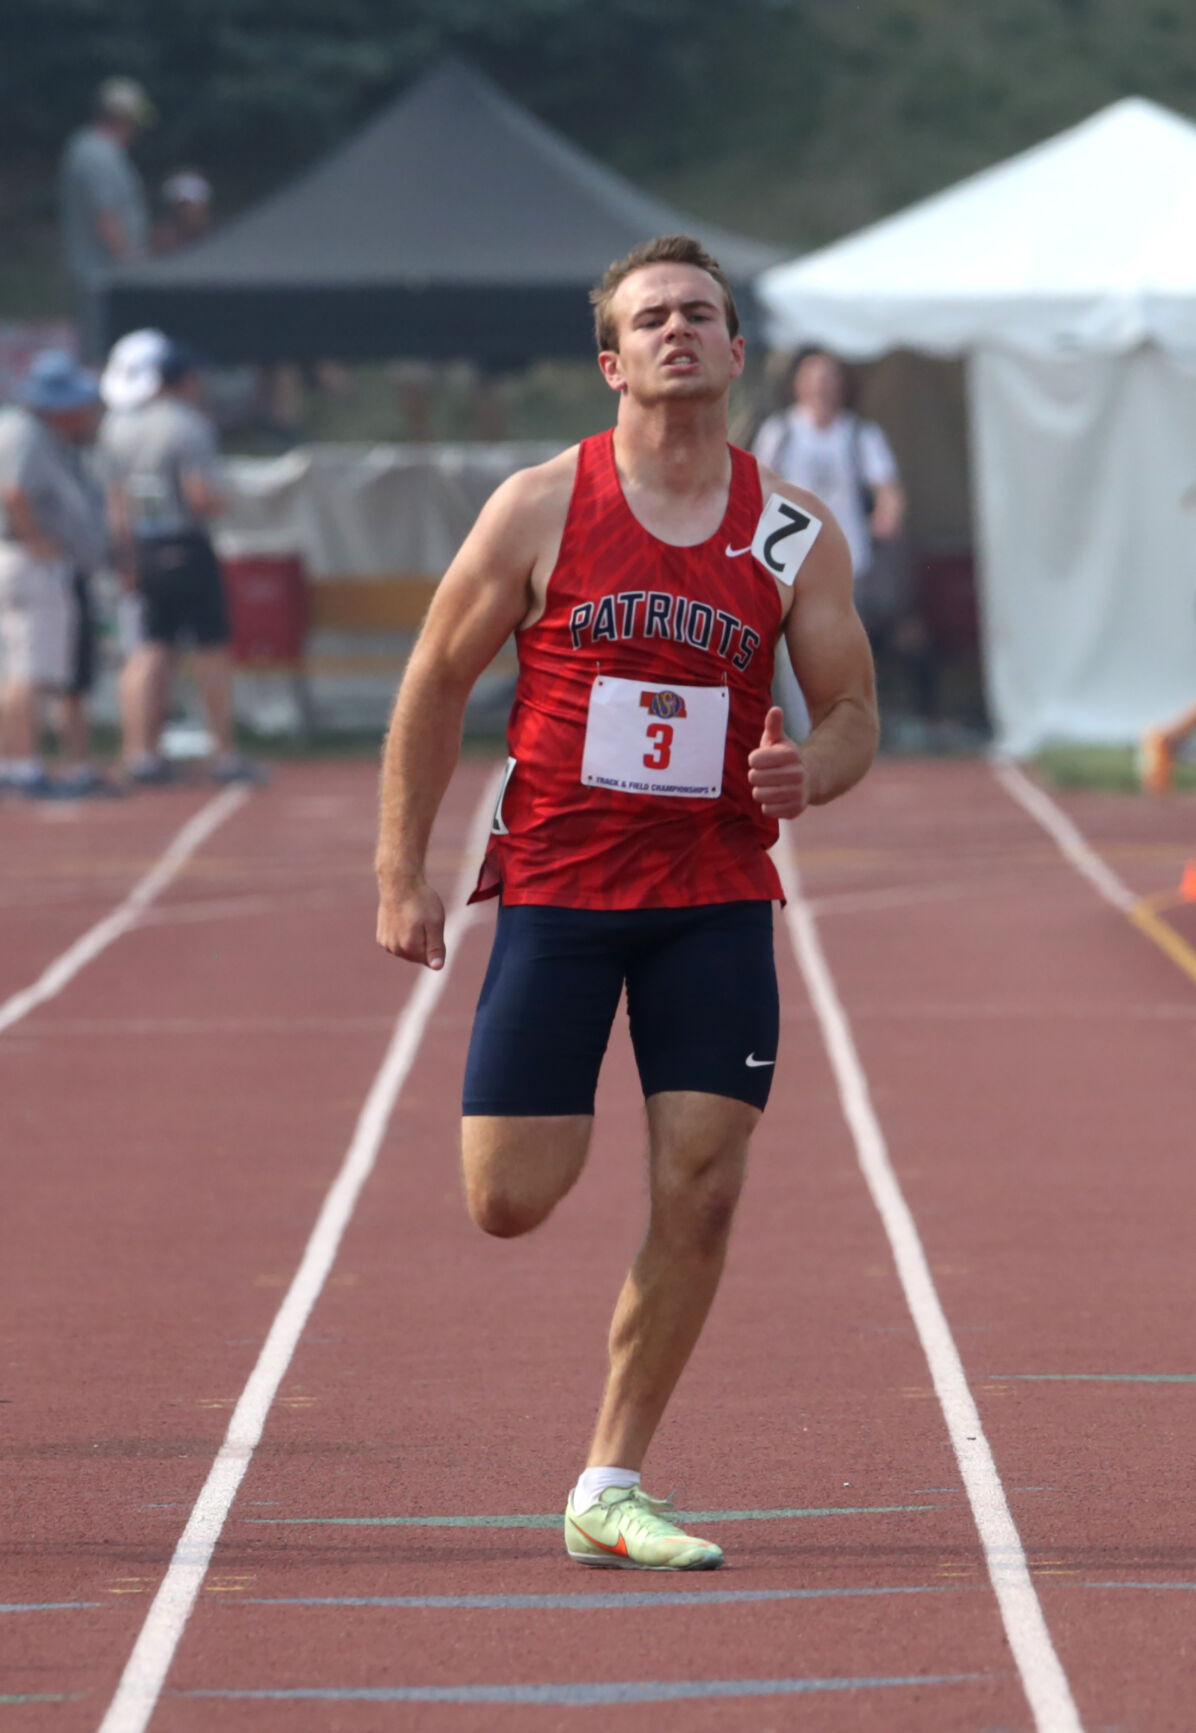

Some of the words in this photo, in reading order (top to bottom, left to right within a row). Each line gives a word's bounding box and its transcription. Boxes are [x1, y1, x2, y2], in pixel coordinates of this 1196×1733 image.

[763, 503, 811, 573] 2
[570, 591, 760, 671] PATRIOTS
[642, 723, 674, 770] 3
[596, 777, 618, 786] TRACK
[629, 782, 649, 790] FIELD
[651, 784, 709, 794] CHAMPIONSHIPS
